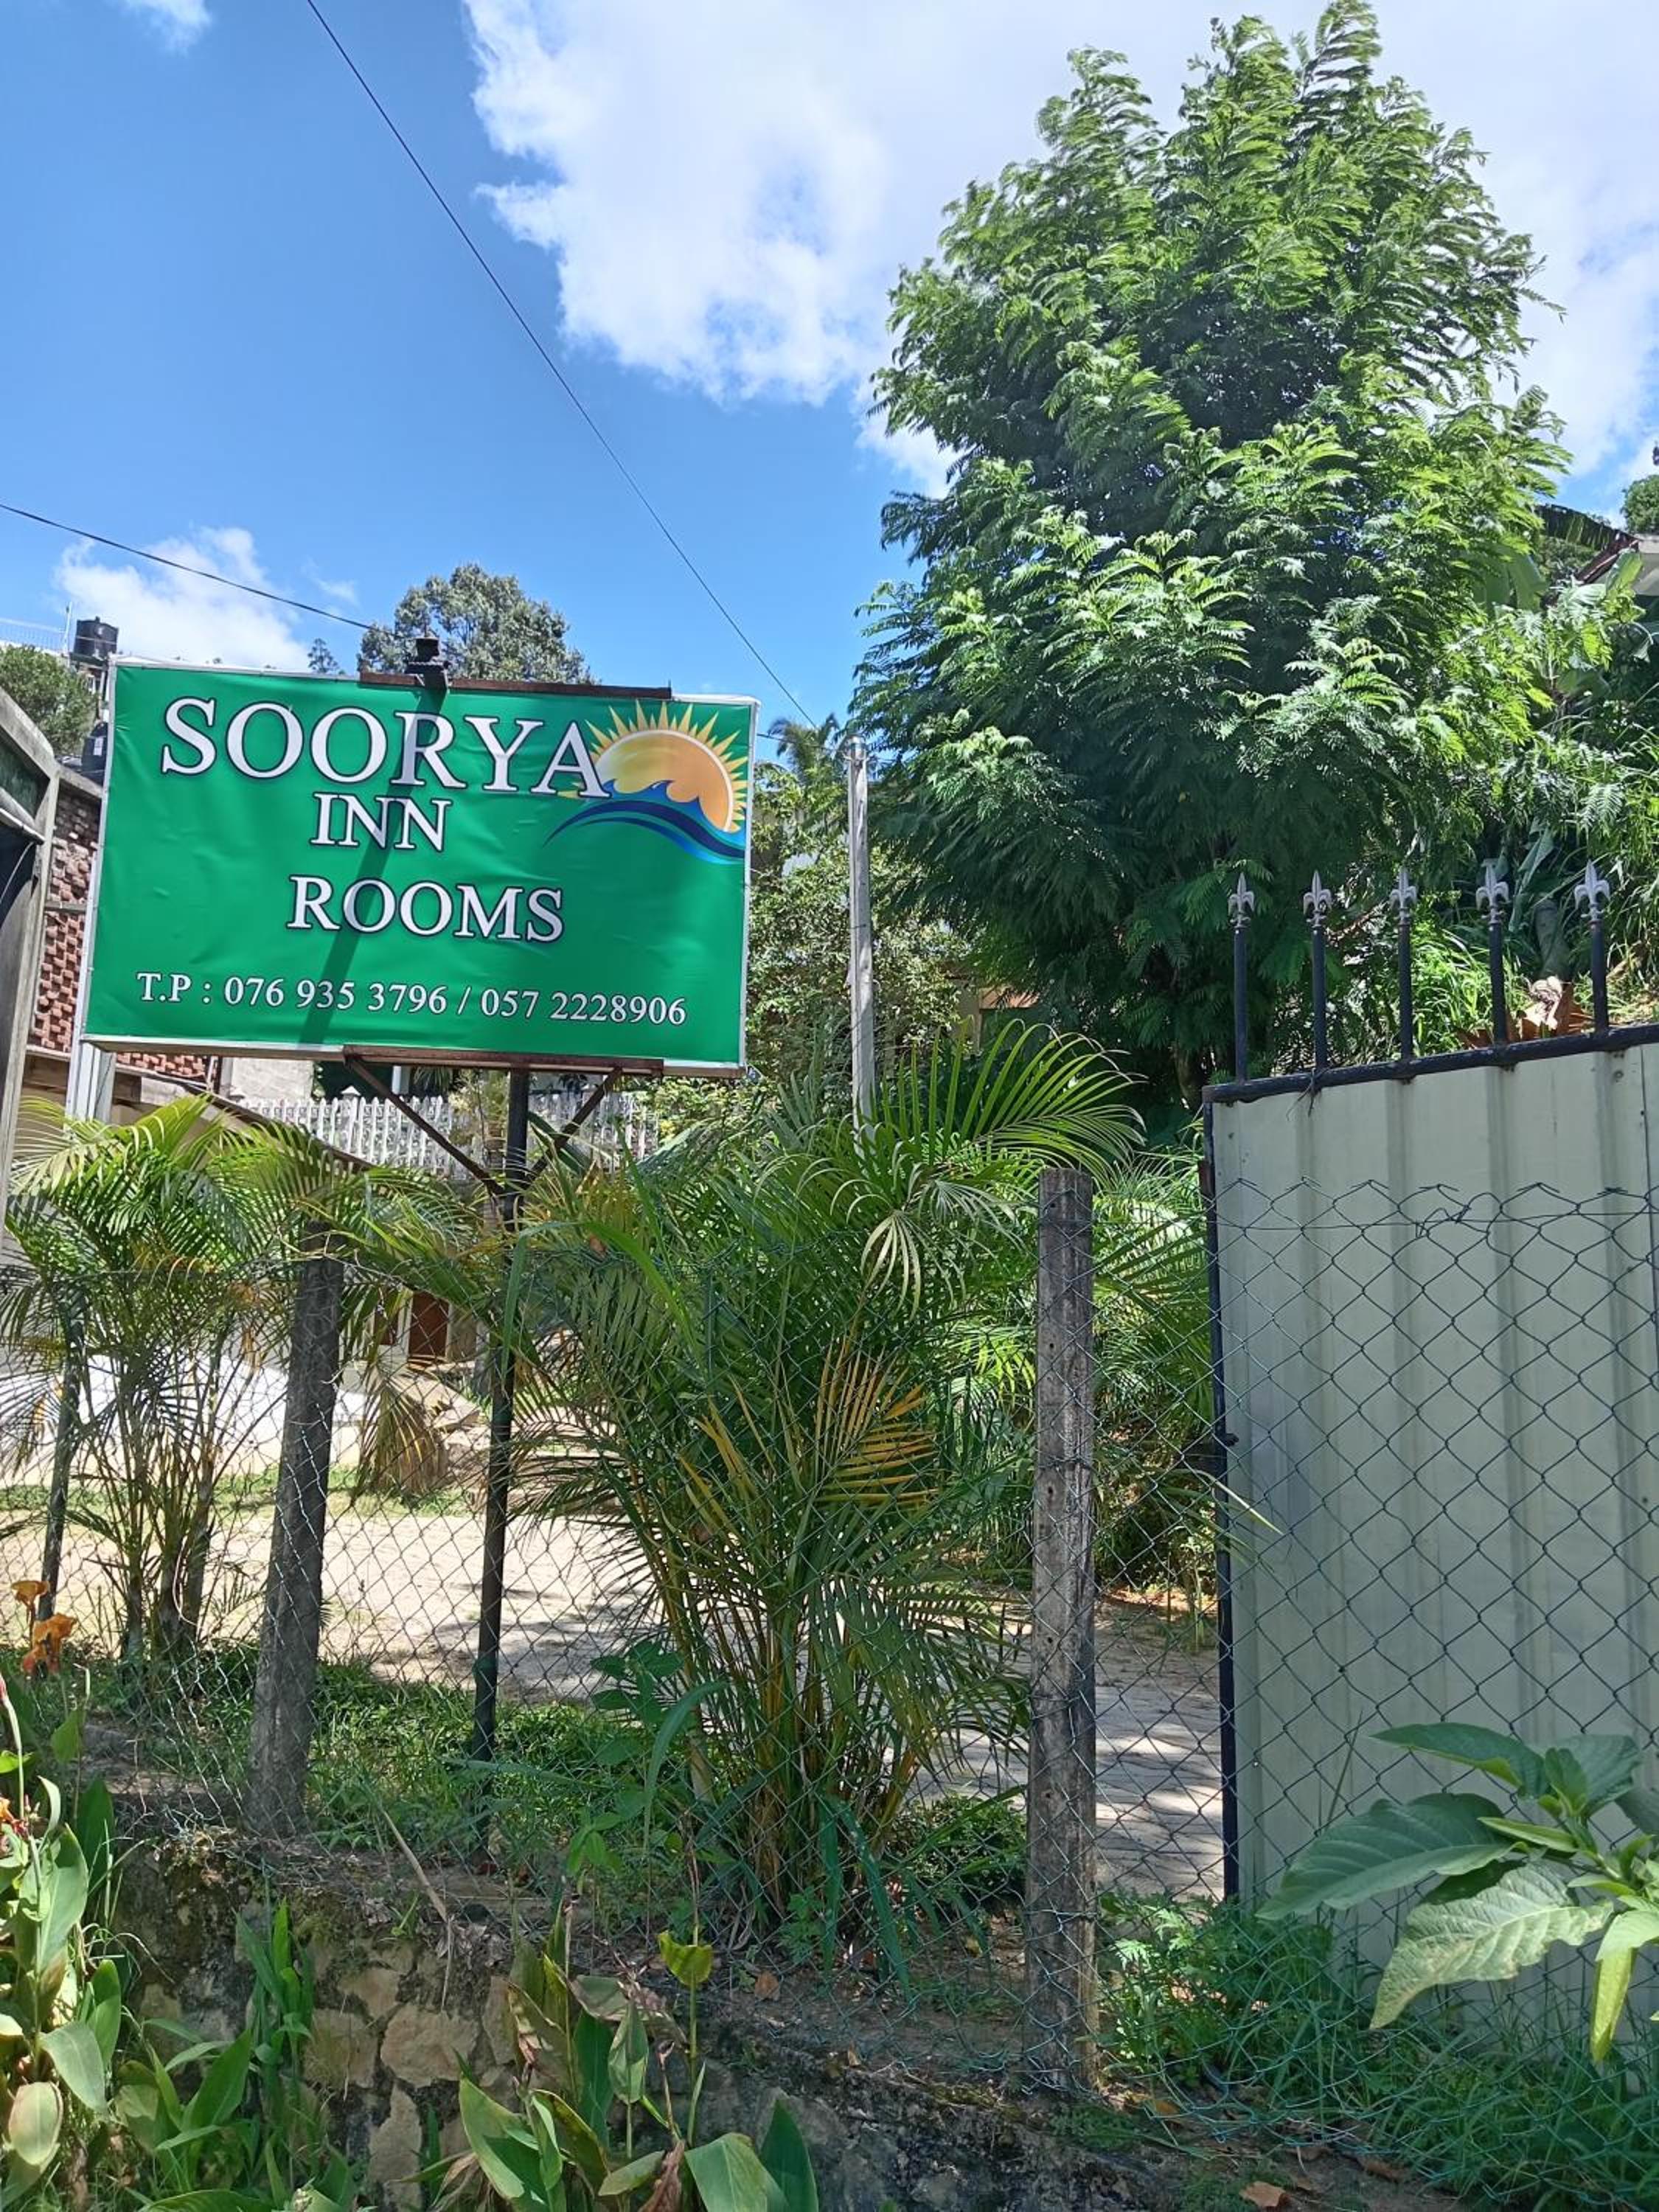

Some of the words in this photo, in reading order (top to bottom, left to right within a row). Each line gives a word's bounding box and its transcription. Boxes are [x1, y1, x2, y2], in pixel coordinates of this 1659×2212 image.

[161, 696, 611, 799] SOORYA
[309, 791, 453, 852] INN
[286, 874, 566, 943] ROOMS
[136, 971, 192, 1003] T.P
[201, 983, 212, 1004] :
[223, 975, 285, 1007] 076
[296, 979, 355, 1010] 935
[367, 981, 448, 1015] 3796
[457, 986, 471, 1015] /
[481, 988, 540, 1018] 057
[549, 991, 687, 1025] 2228906
